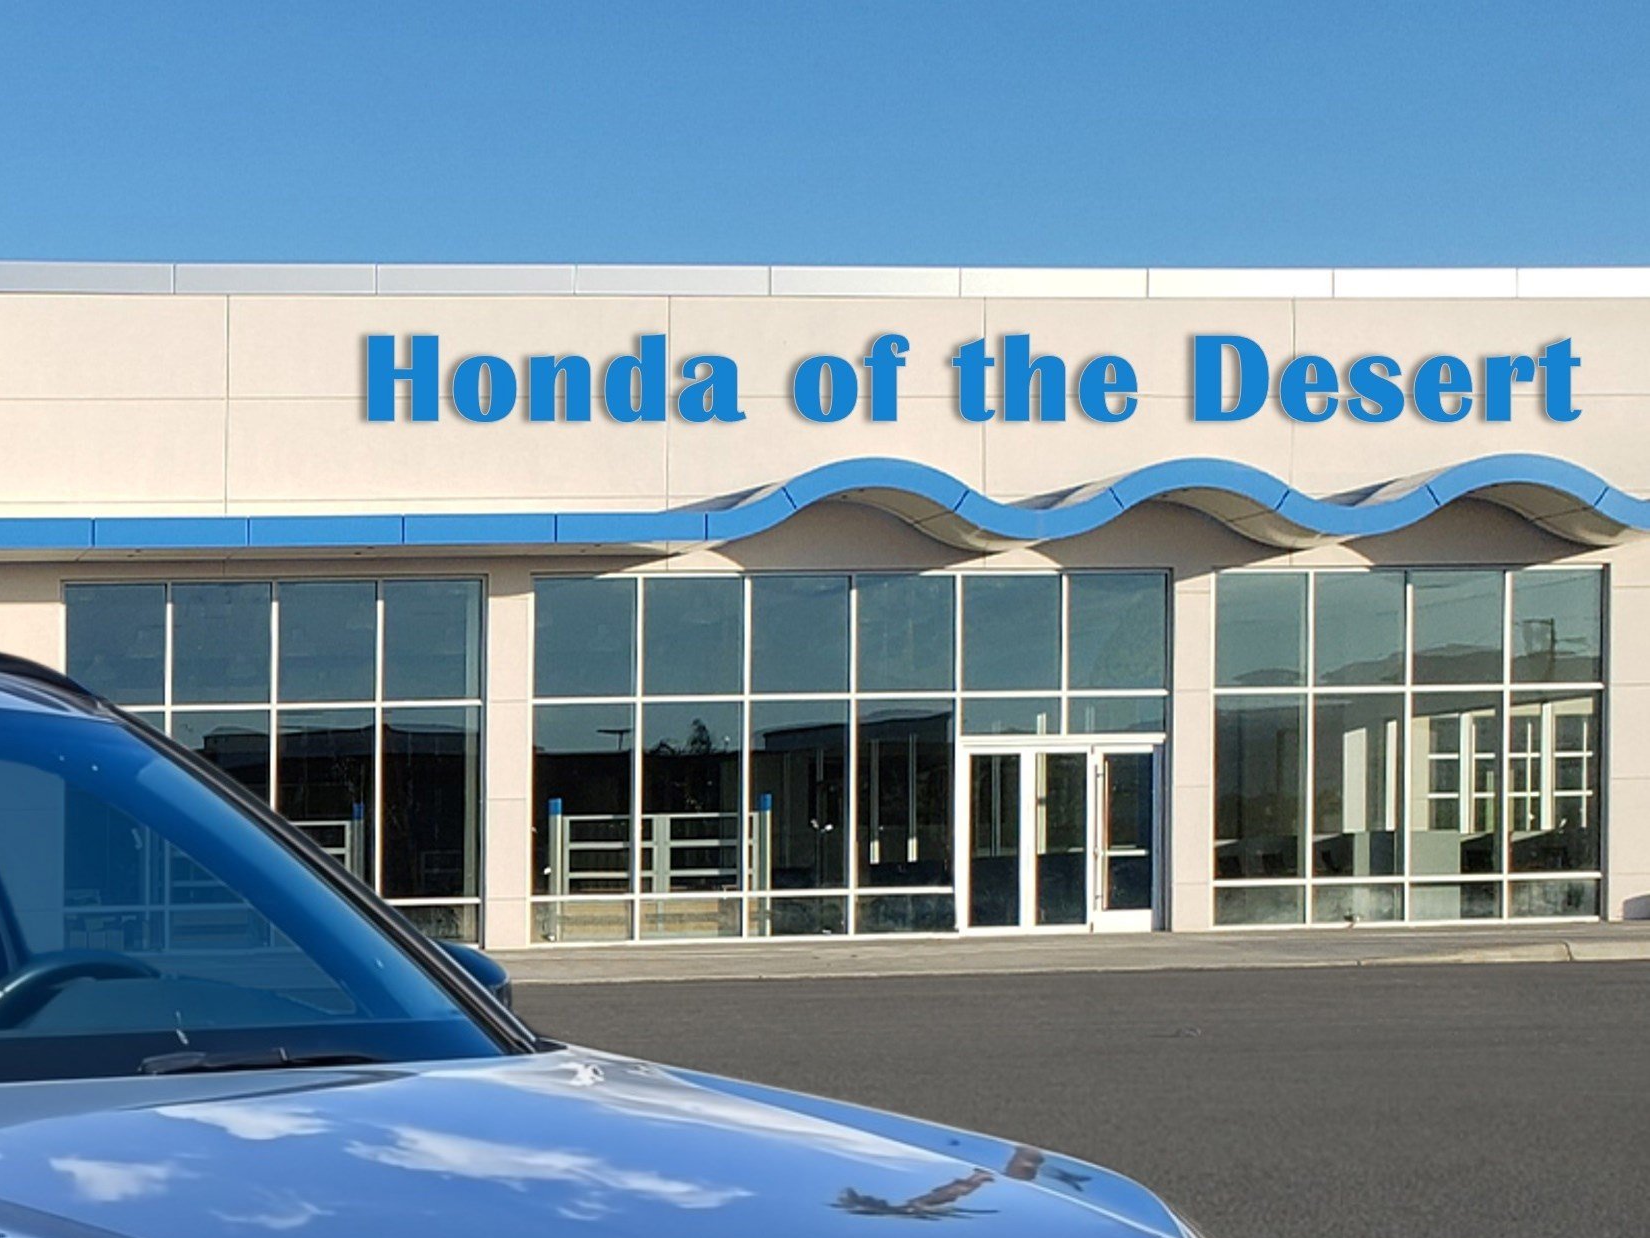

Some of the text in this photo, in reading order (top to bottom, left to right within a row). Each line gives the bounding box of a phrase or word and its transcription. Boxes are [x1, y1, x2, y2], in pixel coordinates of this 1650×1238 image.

[365, 333, 1583, 423] Honda of the Desert
